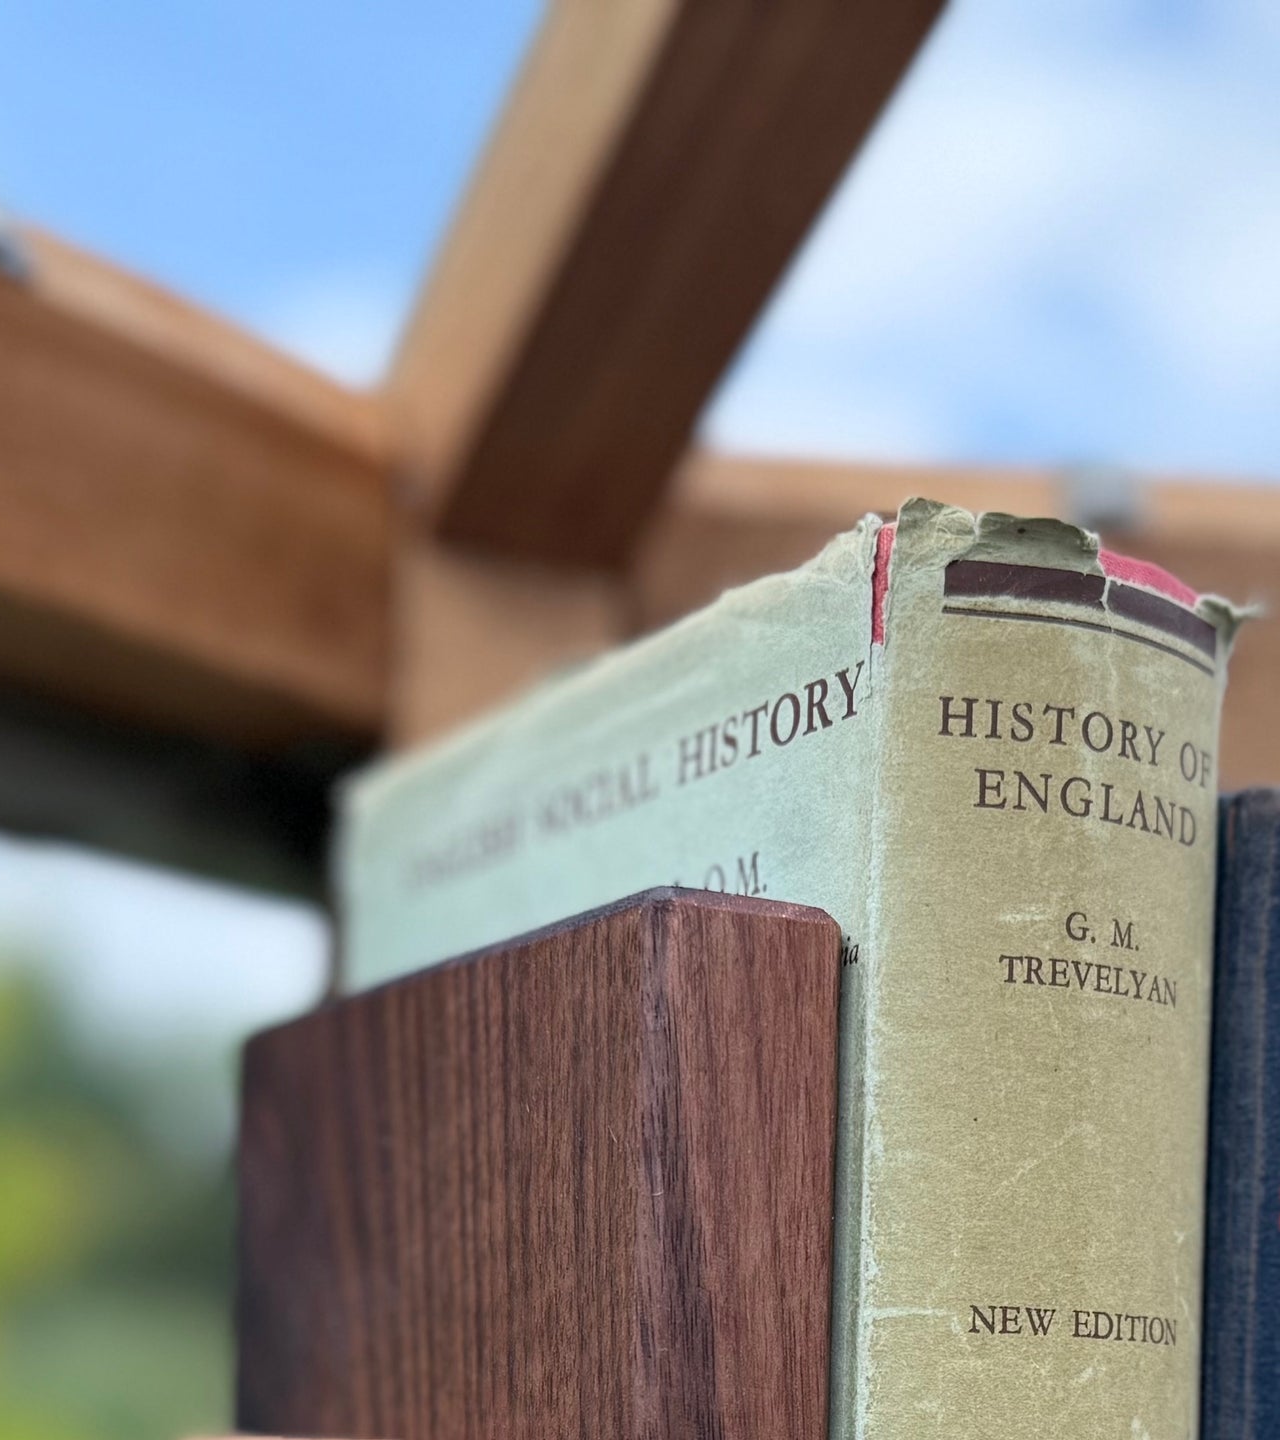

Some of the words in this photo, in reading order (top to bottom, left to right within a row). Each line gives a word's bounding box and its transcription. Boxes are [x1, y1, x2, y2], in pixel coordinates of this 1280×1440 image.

[676, 661, 866, 788] HISTORY
[938, 696, 1166, 767] HISTORY
[1178, 741, 1213, 789] OF
[973, 768, 1198, 847] ENGLAND
[1064, 911, 1097, 944] G.
[1109, 918, 1141, 951] M.
[998, 954, 1178, 1009] TREVELYAN
[968, 1304, 1057, 1336] NEW
[1072, 1309, 1178, 1346] EDITION
